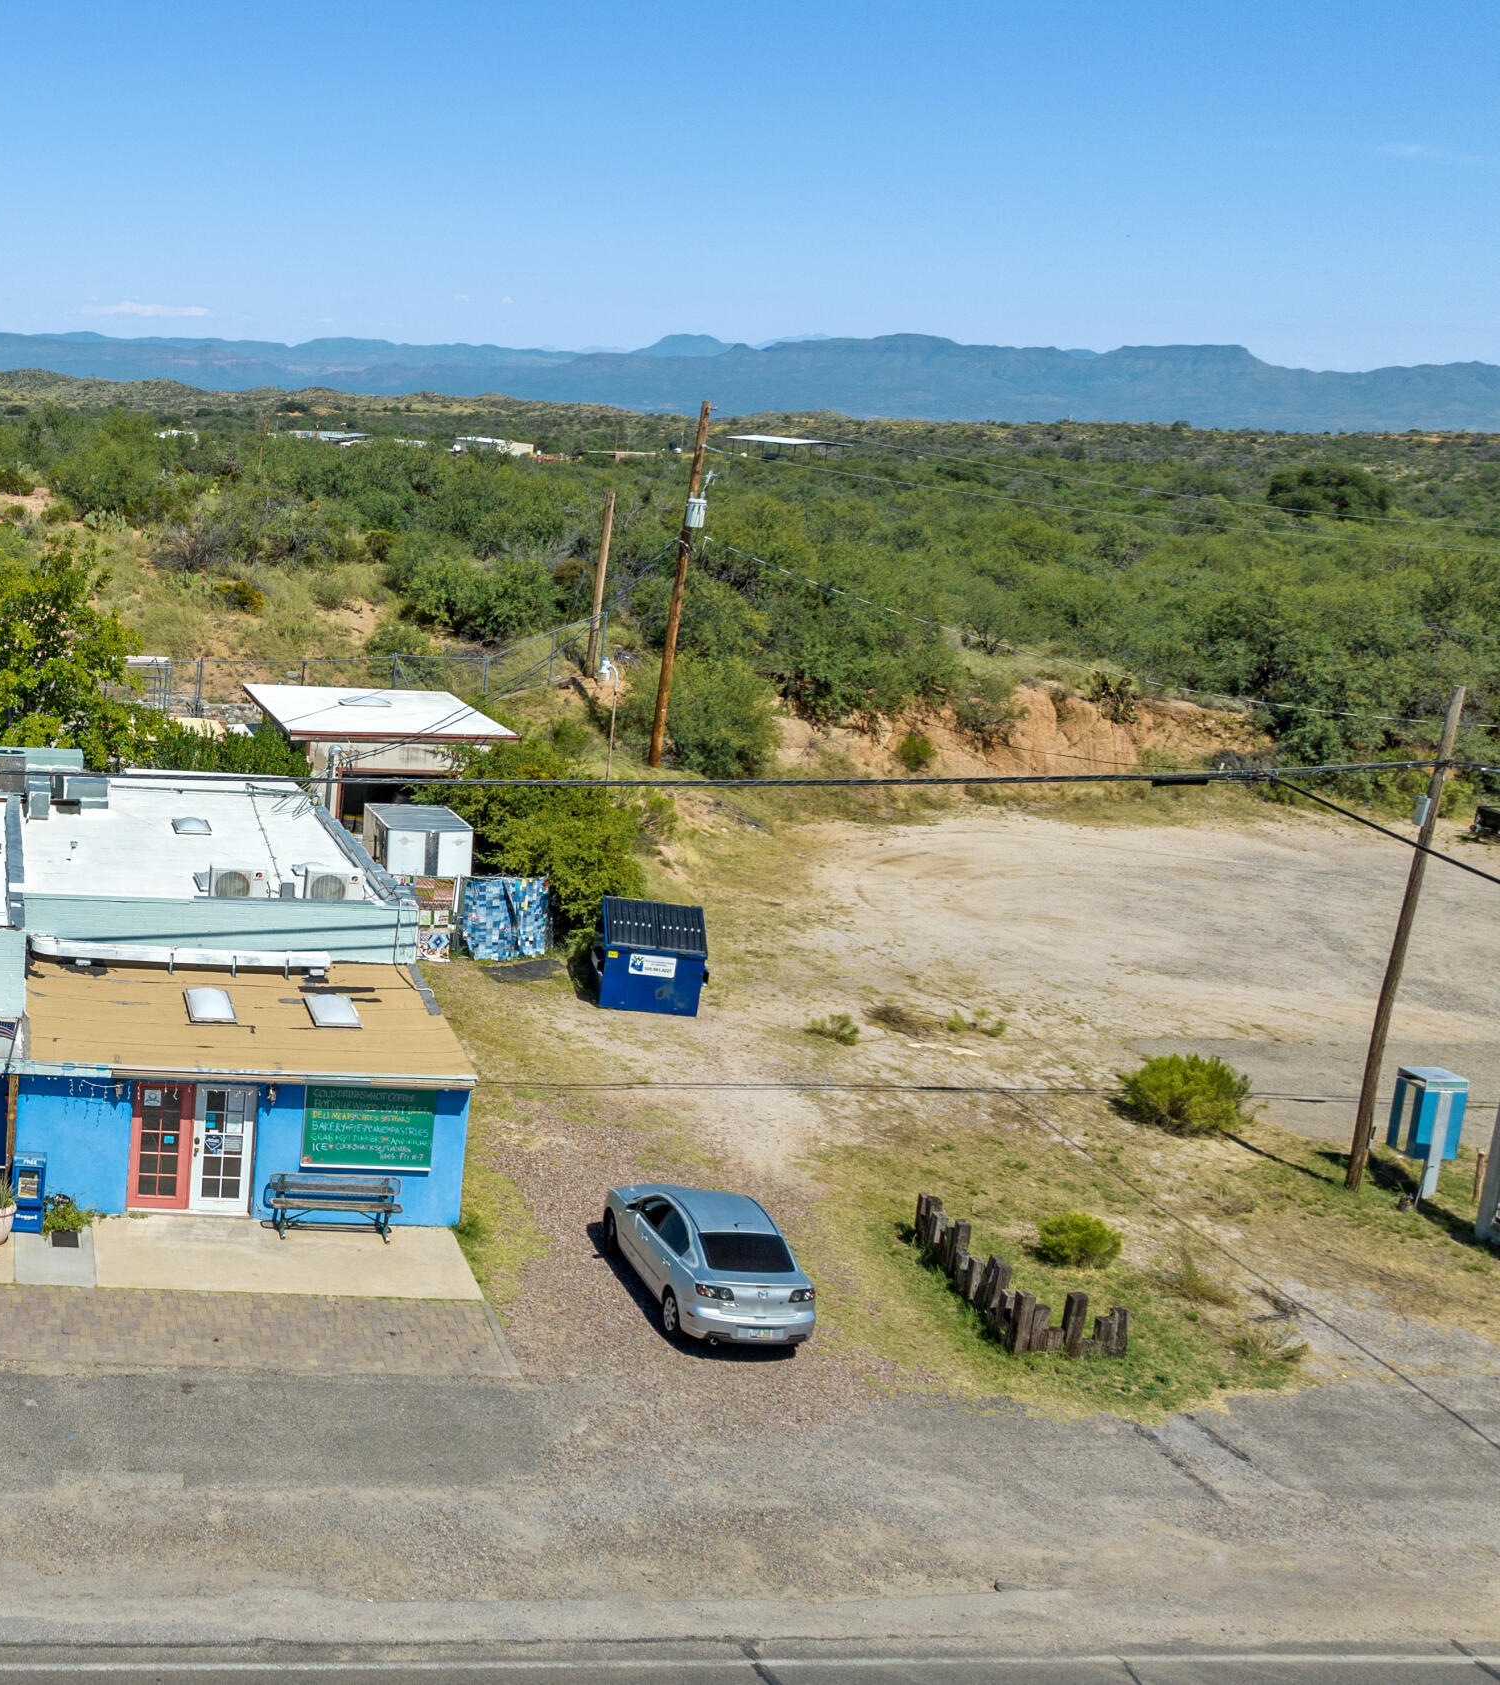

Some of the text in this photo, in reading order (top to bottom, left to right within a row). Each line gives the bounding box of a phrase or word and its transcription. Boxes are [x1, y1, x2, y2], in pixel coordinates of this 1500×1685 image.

[311, 1110, 330, 1119] DELI
[311, 1121, 347, 1132] BAKERY
[391, 1126, 429, 1138] PASTRIES
[311, 1133, 332, 1142] GRAB
[312, 1143, 328, 1152] ICE
